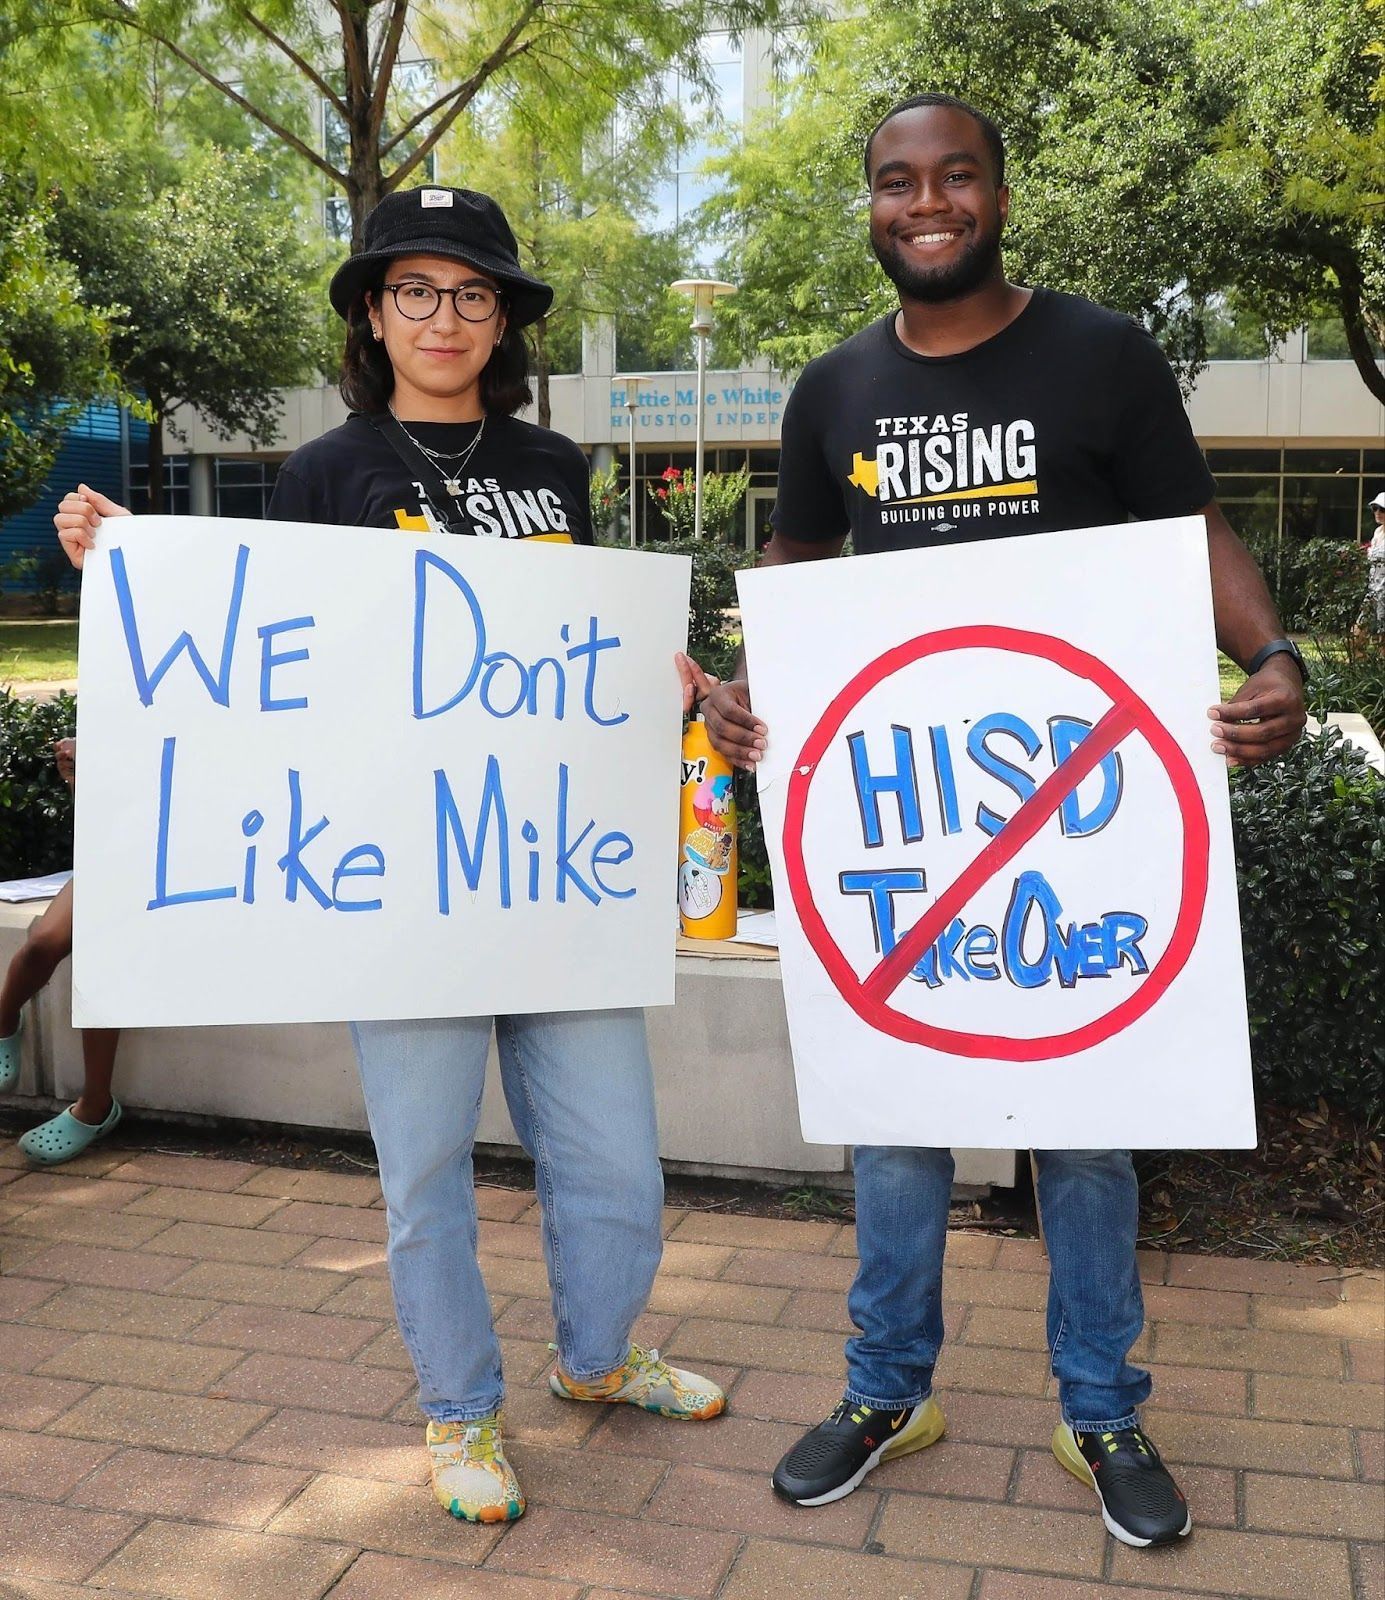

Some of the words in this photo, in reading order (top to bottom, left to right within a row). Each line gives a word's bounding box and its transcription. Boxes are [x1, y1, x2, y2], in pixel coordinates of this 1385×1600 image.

[610, 388, 671, 407] Httie
[676, 387, 717, 406] Me
[722, 386, 782, 405] White
[611, 413, 697, 427] HOUSTO
[717, 412, 779, 426] INDEP
[875, 412, 969, 437] TEXAS
[876, 419, 1037, 501] RISING
[412, 478, 500, 498] TXAS
[420, 488, 570, 538] SING
[881, 506, 945, 525] BUILDING
[952, 504, 981, 519] OUR
[988, 500, 1040, 516] POWER
[109, 544, 315, 712] WE
[411, 549, 629, 726] Don't
[847, 712, 1123, 848] HISD
[146, 737, 386, 912] Like
[434, 754, 638, 915] Mike
